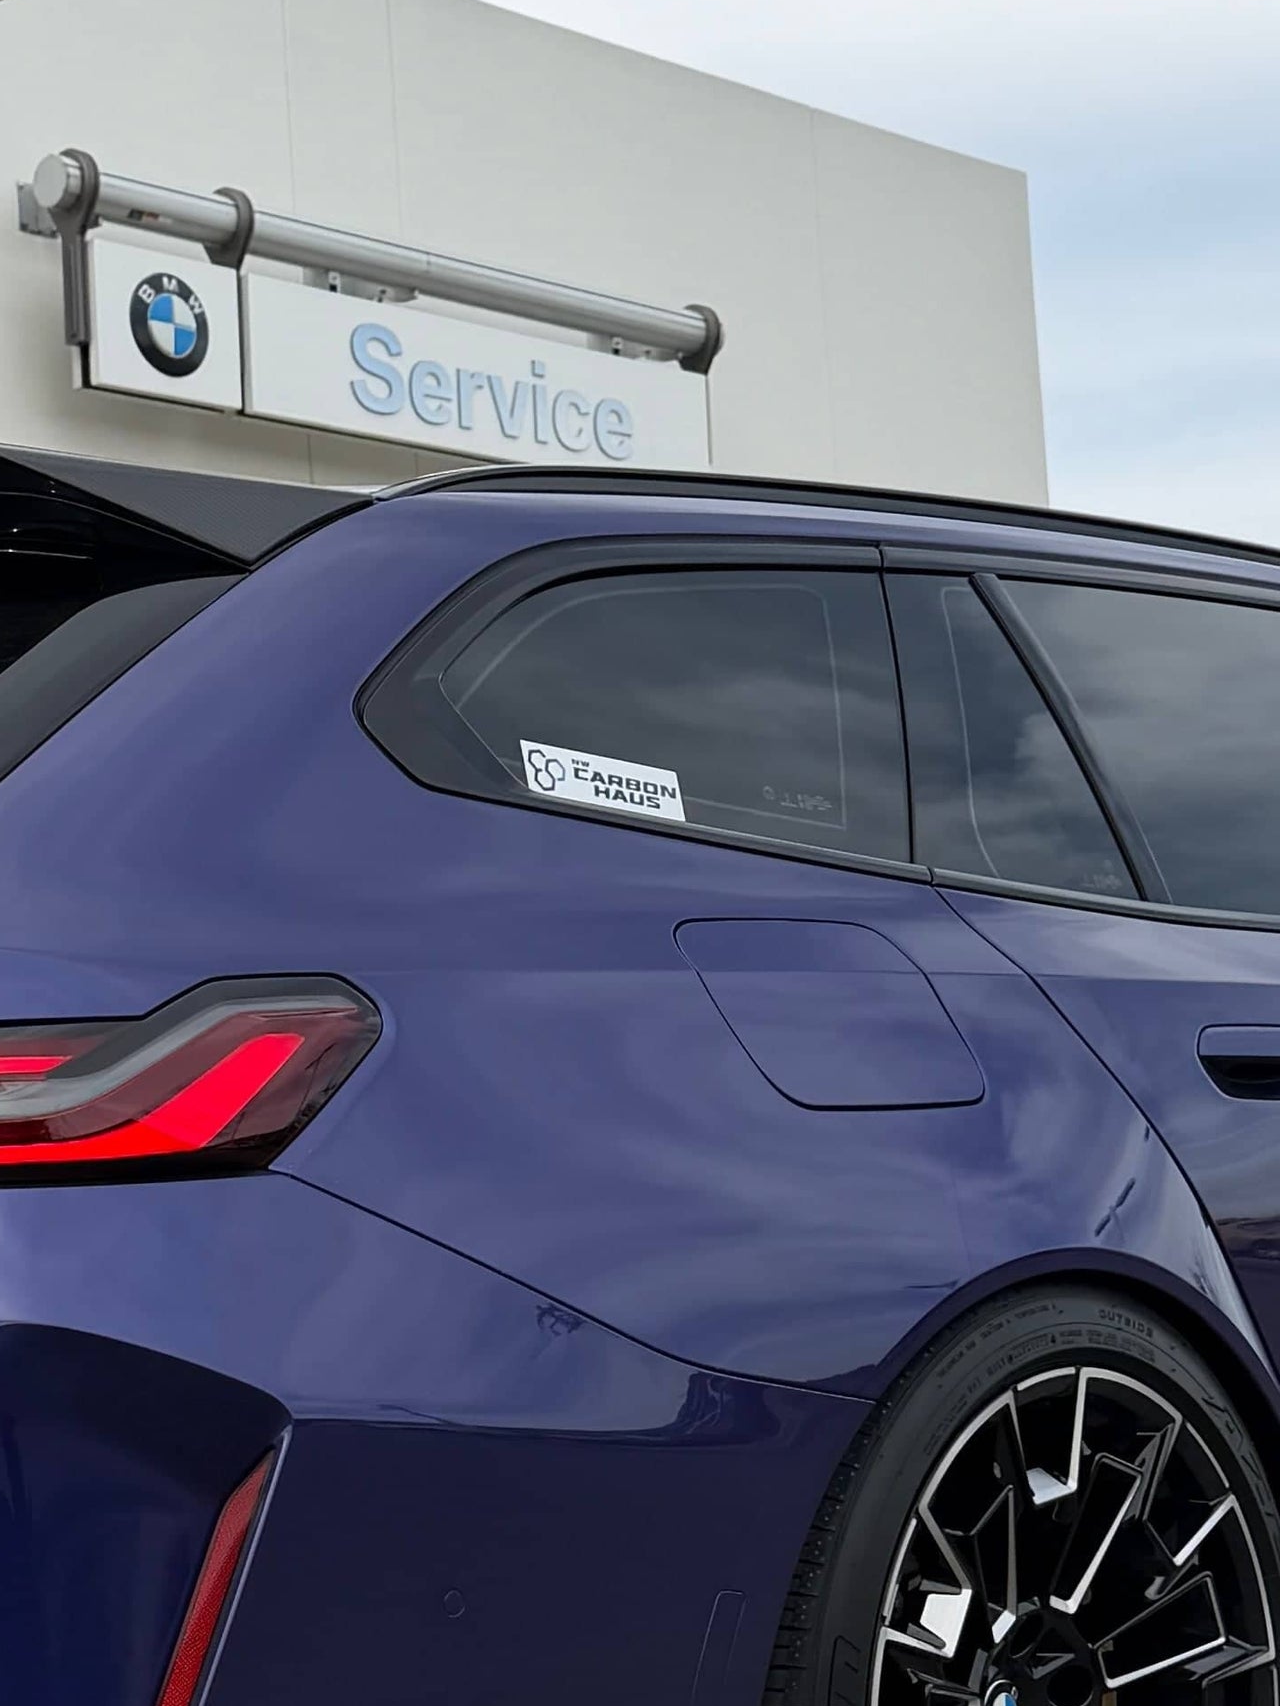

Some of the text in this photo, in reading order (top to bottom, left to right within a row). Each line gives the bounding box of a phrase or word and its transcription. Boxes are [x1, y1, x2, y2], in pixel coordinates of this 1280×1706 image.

[138, 275, 205, 315] BMW
[349, 323, 634, 460] Service
[573, 767, 676, 798] CARBON
[594, 785, 660, 809] HAUS
